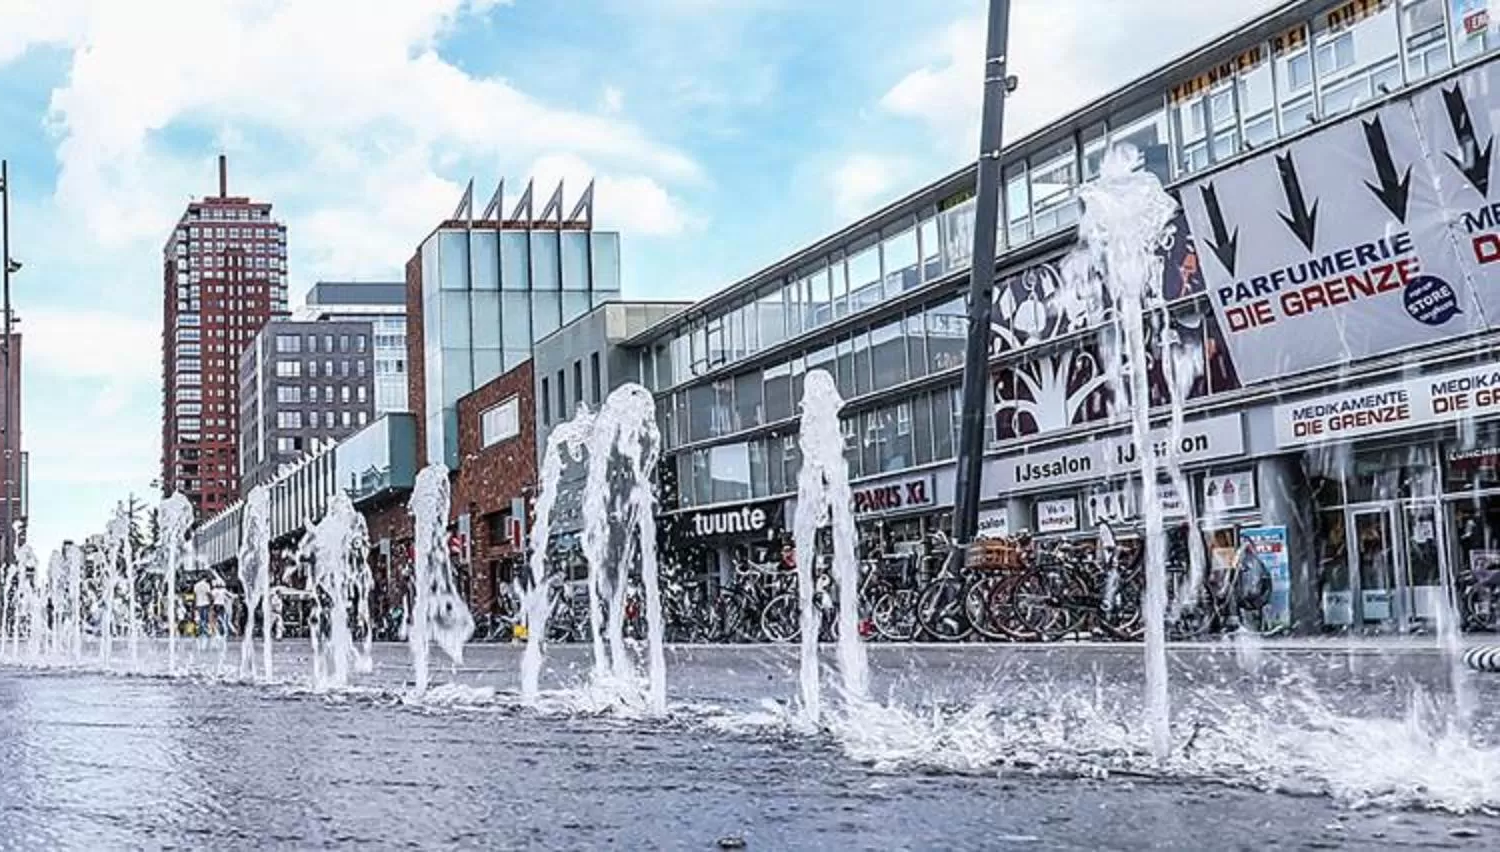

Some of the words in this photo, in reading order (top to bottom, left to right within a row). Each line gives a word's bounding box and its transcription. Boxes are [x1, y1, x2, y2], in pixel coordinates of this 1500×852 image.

[1218, 231, 1415, 307] PARFUMERIE
[1225, 300, 1276, 333] DIE
[1280, 257, 1422, 317] GRENZE
[1408, 285, 1451, 314] STORE
[1293, 390, 1409, 421] MEDIKAMENTE
[1432, 394, 1469, 414] DIE
[1294, 419, 1323, 437] DIE
[1329, 404, 1410, 431] GRENZE
[1015, 455, 1091, 483] IJssalon
[854, 486, 901, 513] PARIS
[905, 480, 929, 506] XL
[693, 506, 766, 535] tuunte
